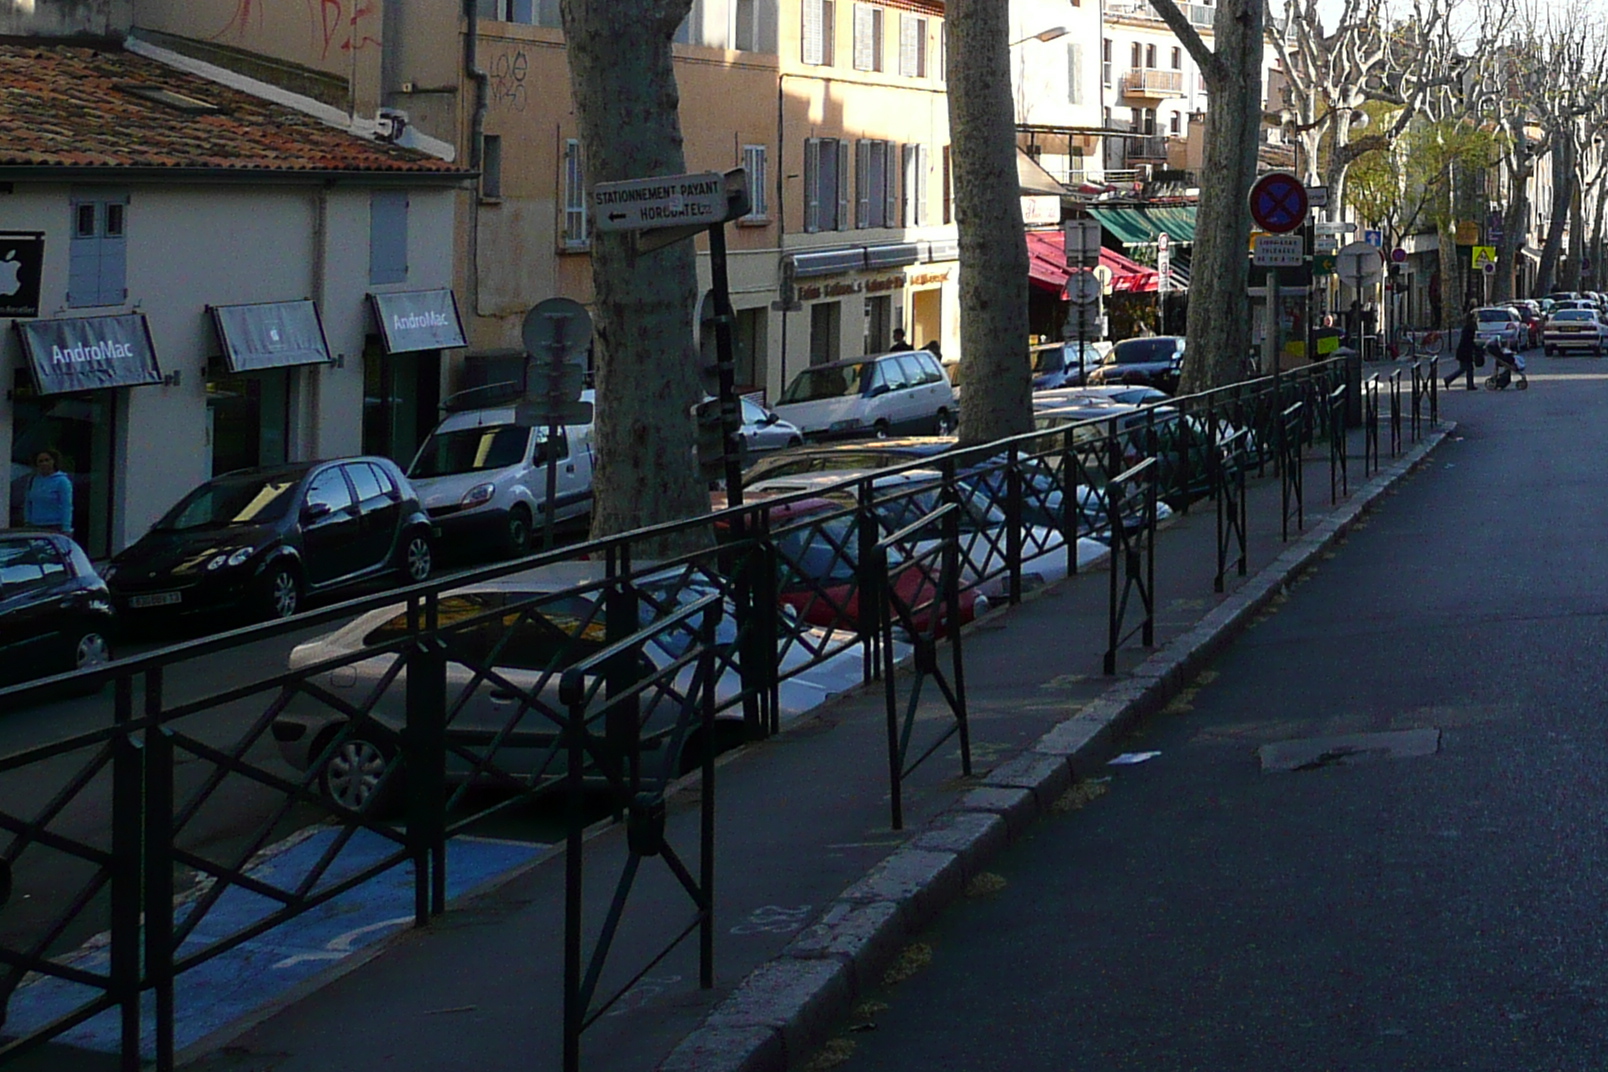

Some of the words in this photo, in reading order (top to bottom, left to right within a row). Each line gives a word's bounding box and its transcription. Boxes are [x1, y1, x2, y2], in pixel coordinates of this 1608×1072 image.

[596, 185, 676, 205] STATIONNEMENT
[681, 181, 718, 196] PAYANT
[641, 203, 713, 221] HORODTEU
[393, 310, 448, 330] AndroMac
[52, 340, 133, 364] AndroMac
